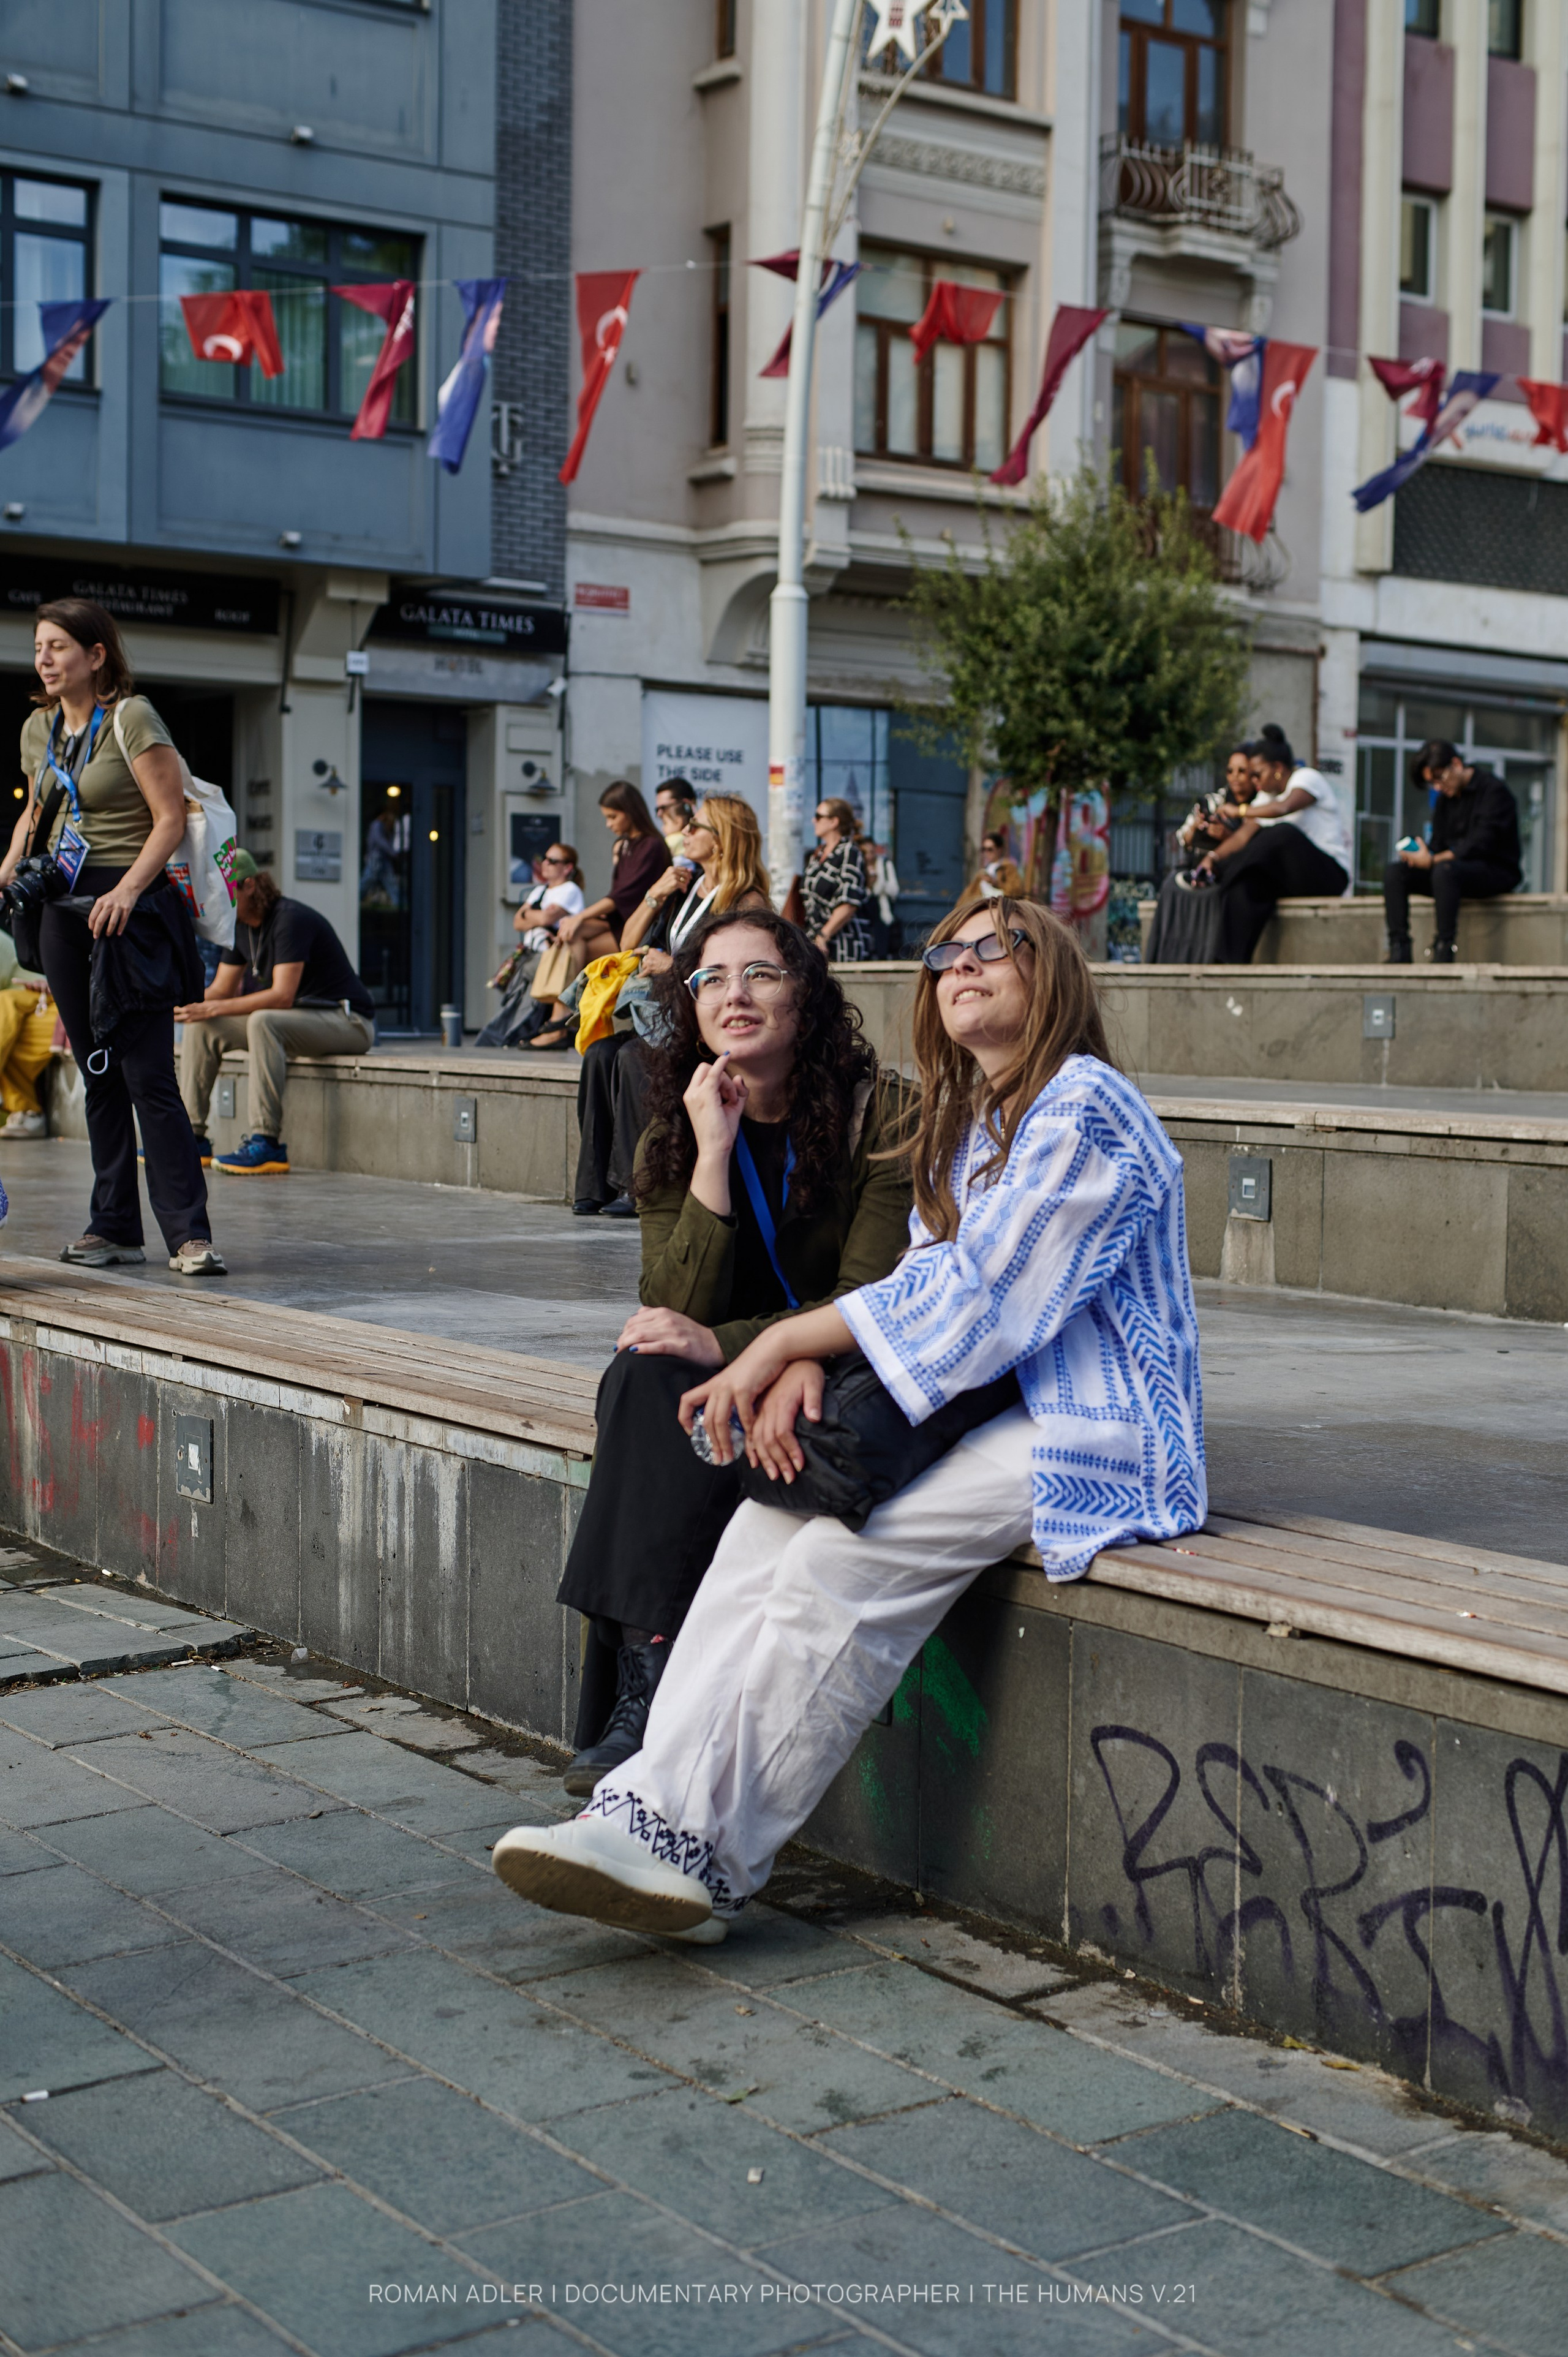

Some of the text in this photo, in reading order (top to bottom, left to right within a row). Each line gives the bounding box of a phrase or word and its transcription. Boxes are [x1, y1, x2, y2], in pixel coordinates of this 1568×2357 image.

[73, 579, 189, 605] GALATA TIMES
[400, 603, 475, 627] GALATA
[478, 610, 535, 635] TIMES
[657, 744, 744, 764] PLEASE USE
[658, 764, 723, 782] THE SIDE
